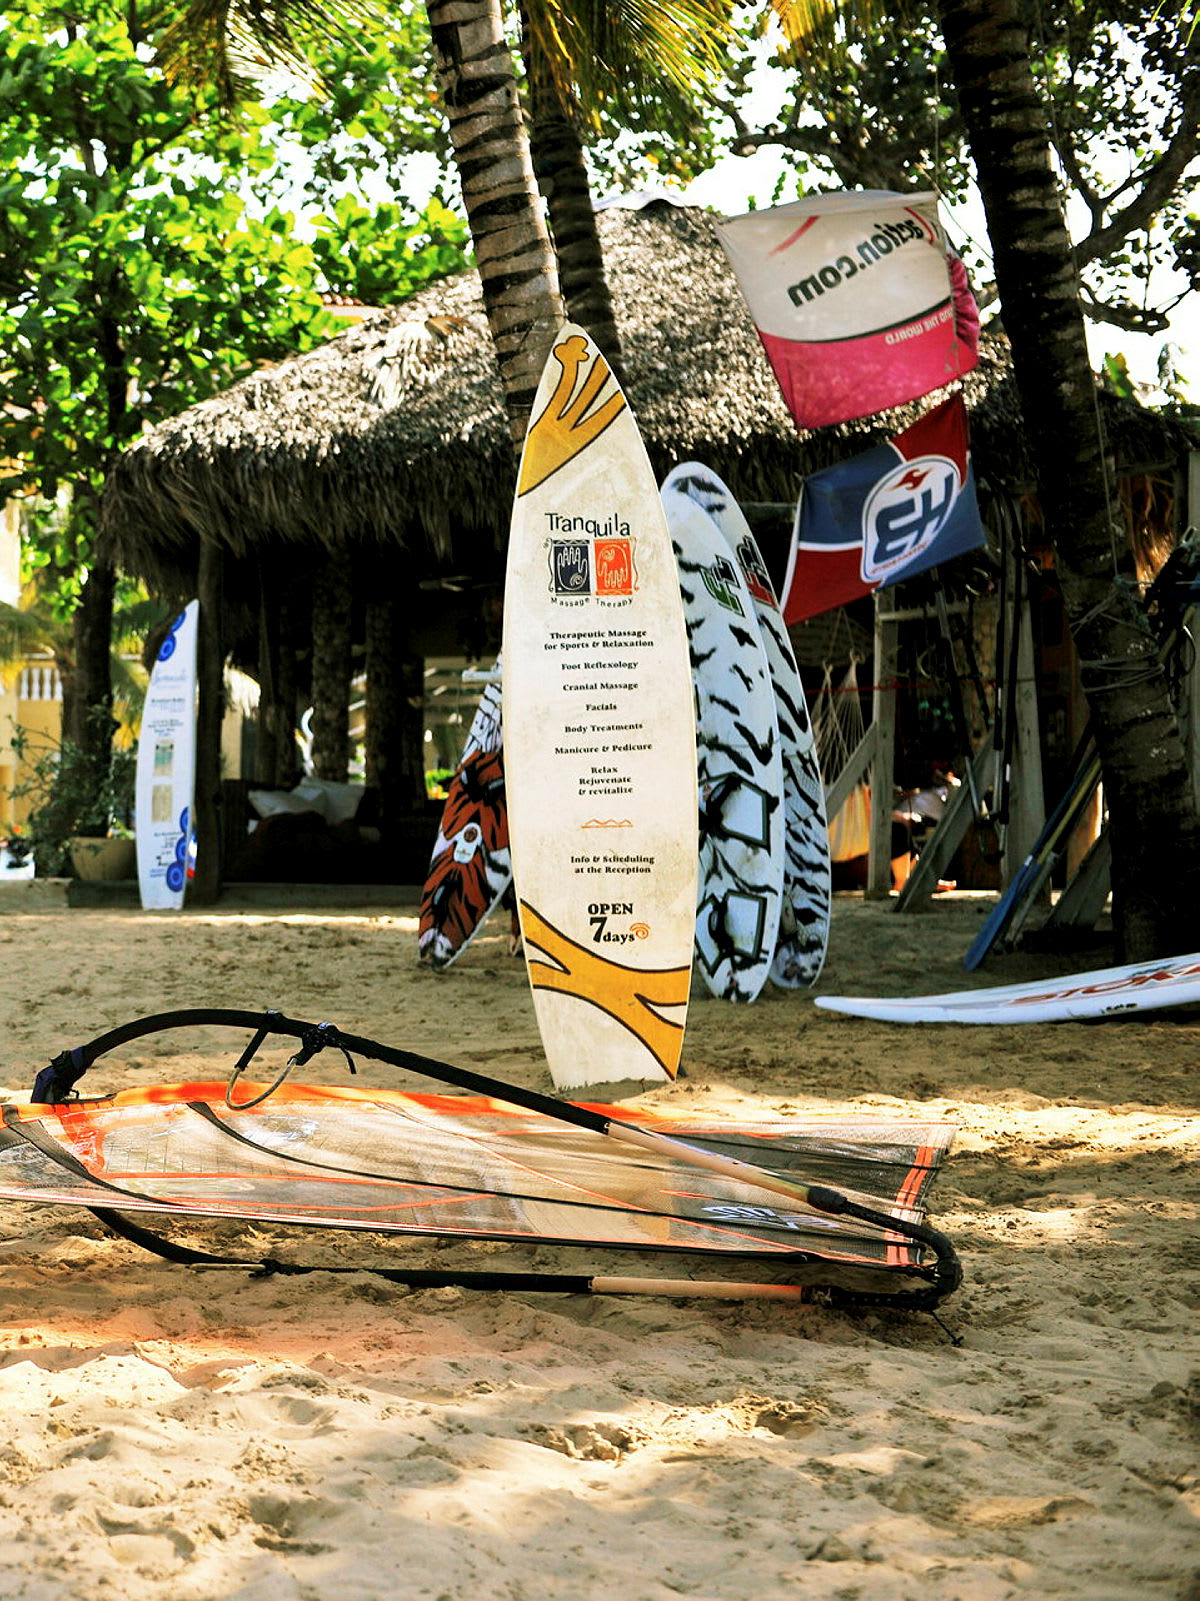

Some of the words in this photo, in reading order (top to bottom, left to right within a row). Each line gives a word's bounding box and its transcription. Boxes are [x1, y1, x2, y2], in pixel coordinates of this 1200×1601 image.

[544, 512, 631, 538] Tranquila
[550, 597, 590, 607] Massage
[596, 597, 634, 608] Therapy
[550, 630, 606, 640] Therapeutic
[608, 629, 647, 639] Massage
[544, 642, 558, 651] for
[560, 641, 590, 651] Sports
[602, 639, 654, 648] Relaxation
[561, 662, 581, 670] Foot
[584, 660, 639, 670] Reflexology
[562, 682, 598, 691] Cranial
[600, 682, 639, 691] Massage
[585, 703, 618, 711] Facials
[564, 725, 588, 734] Body
[590, 722, 643, 732] Treatments
[554, 746, 599, 755] Manicure
[612, 743, 653, 752] Pedicure
[591, 766, 619, 774] Relax
[579, 776, 632, 786] Rejuvenate
[578, 788, 586, 796] &
[589, 786, 634, 795] revitalize
[571, 855, 591, 864] Info
[593, 855, 601, 863] &
[602, 855, 655, 865] Scheduling
[574, 866, 584, 874] at
[587, 866, 601, 874] the
[605, 866, 651, 875] Reception
[587, 903, 634, 915] OPEN
